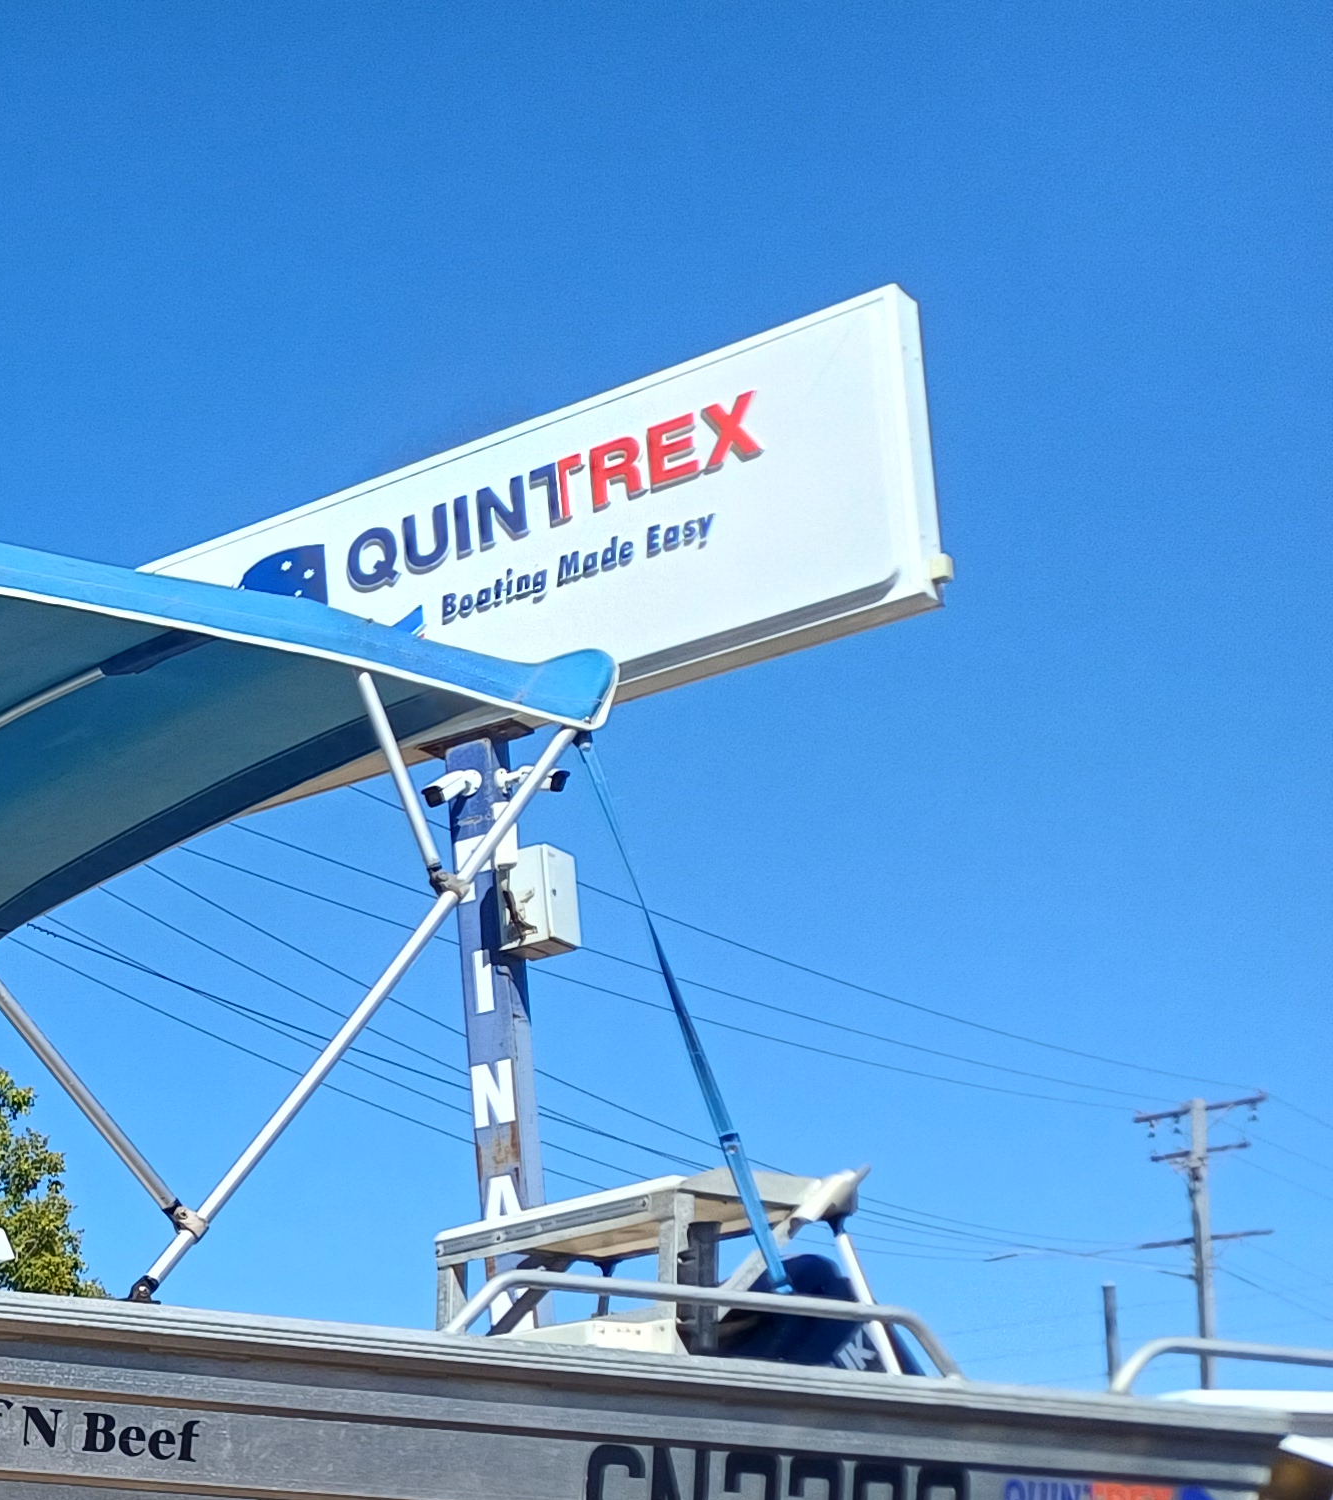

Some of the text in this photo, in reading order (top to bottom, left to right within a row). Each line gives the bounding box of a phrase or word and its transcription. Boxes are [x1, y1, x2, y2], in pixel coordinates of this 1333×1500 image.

[347, 389, 764, 592] QUINTREX
[442, 513, 717, 625] Boating Made Easy
[21, 1405, 63, 1448] N
[81, 1411, 200, 1463] Beef
